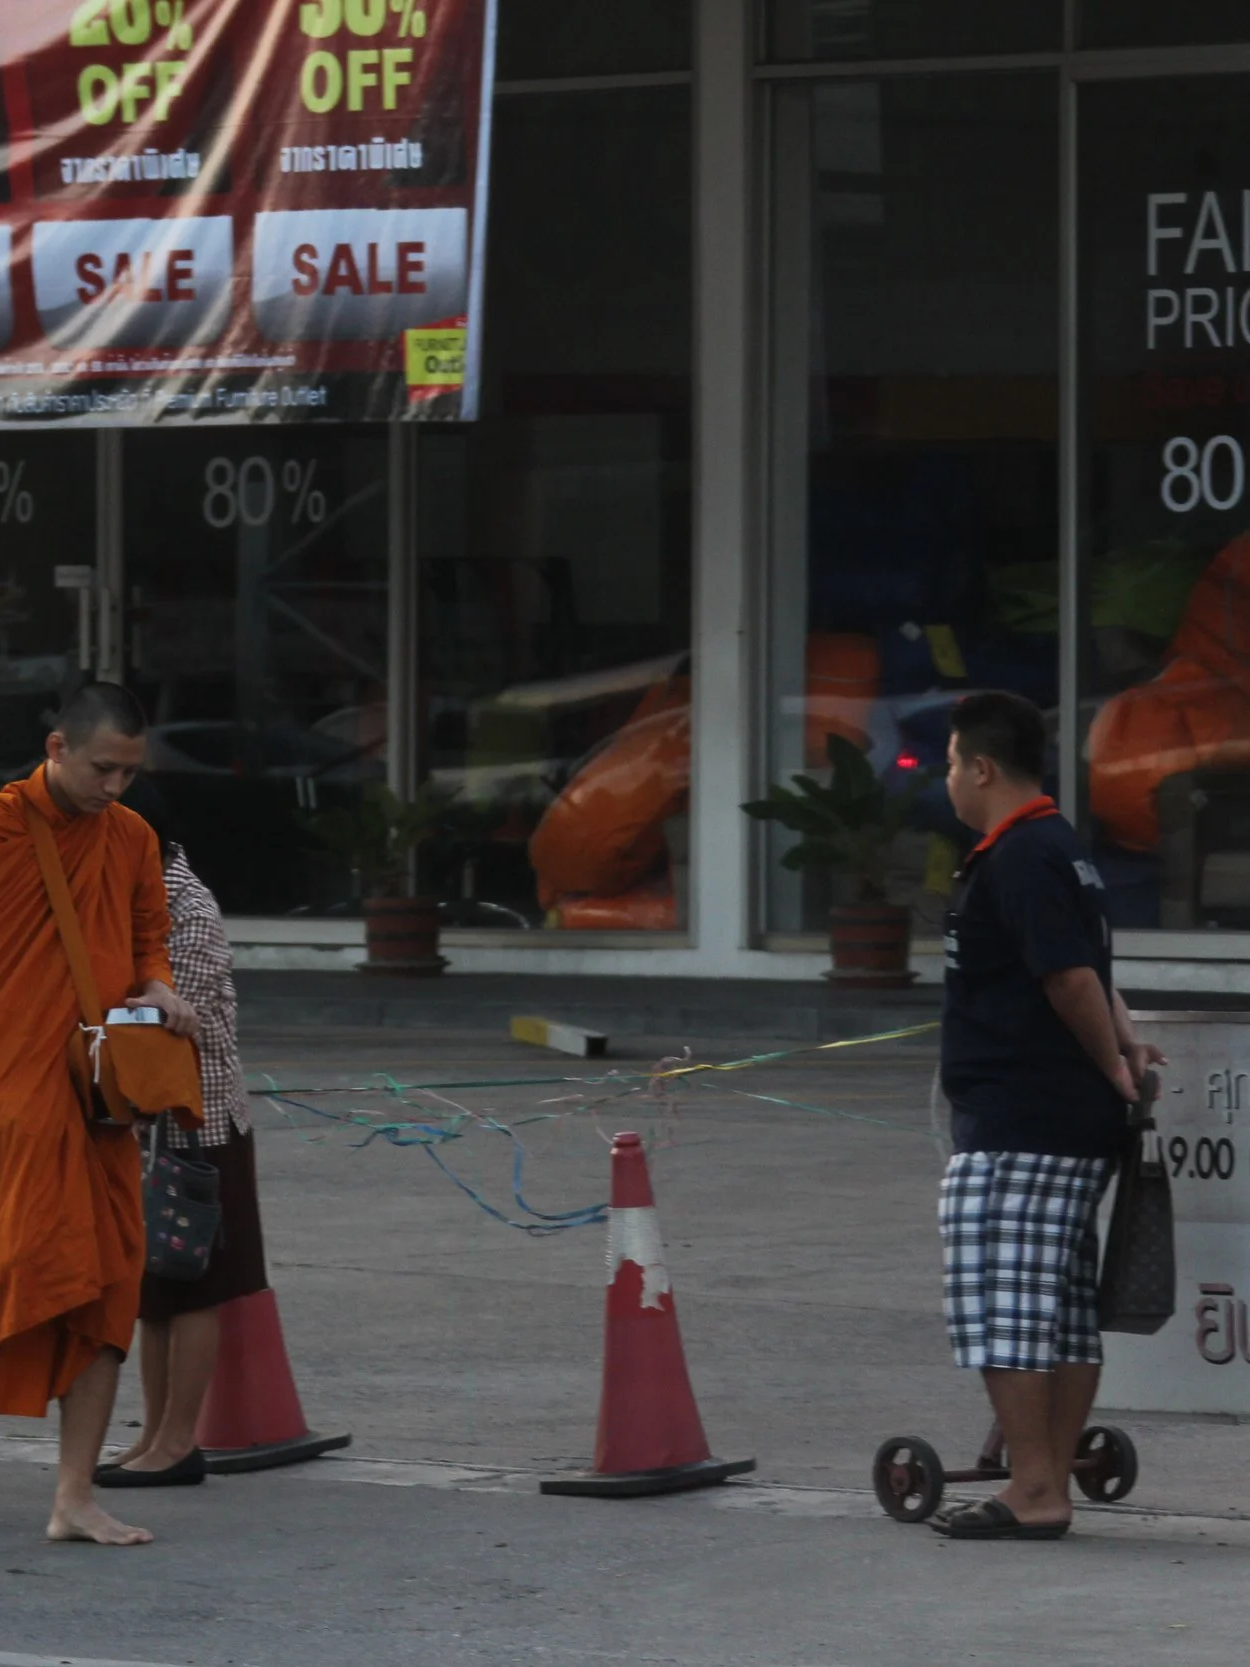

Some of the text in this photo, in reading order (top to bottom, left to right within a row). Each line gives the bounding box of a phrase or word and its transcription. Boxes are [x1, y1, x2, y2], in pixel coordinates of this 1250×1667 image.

[78, 60, 187, 126] OFF
[301, 48, 414, 114] OFF
[75, 248, 195, 304] SALE
[292, 241, 427, 296] SALE
[203, 457, 327, 528] 80%
